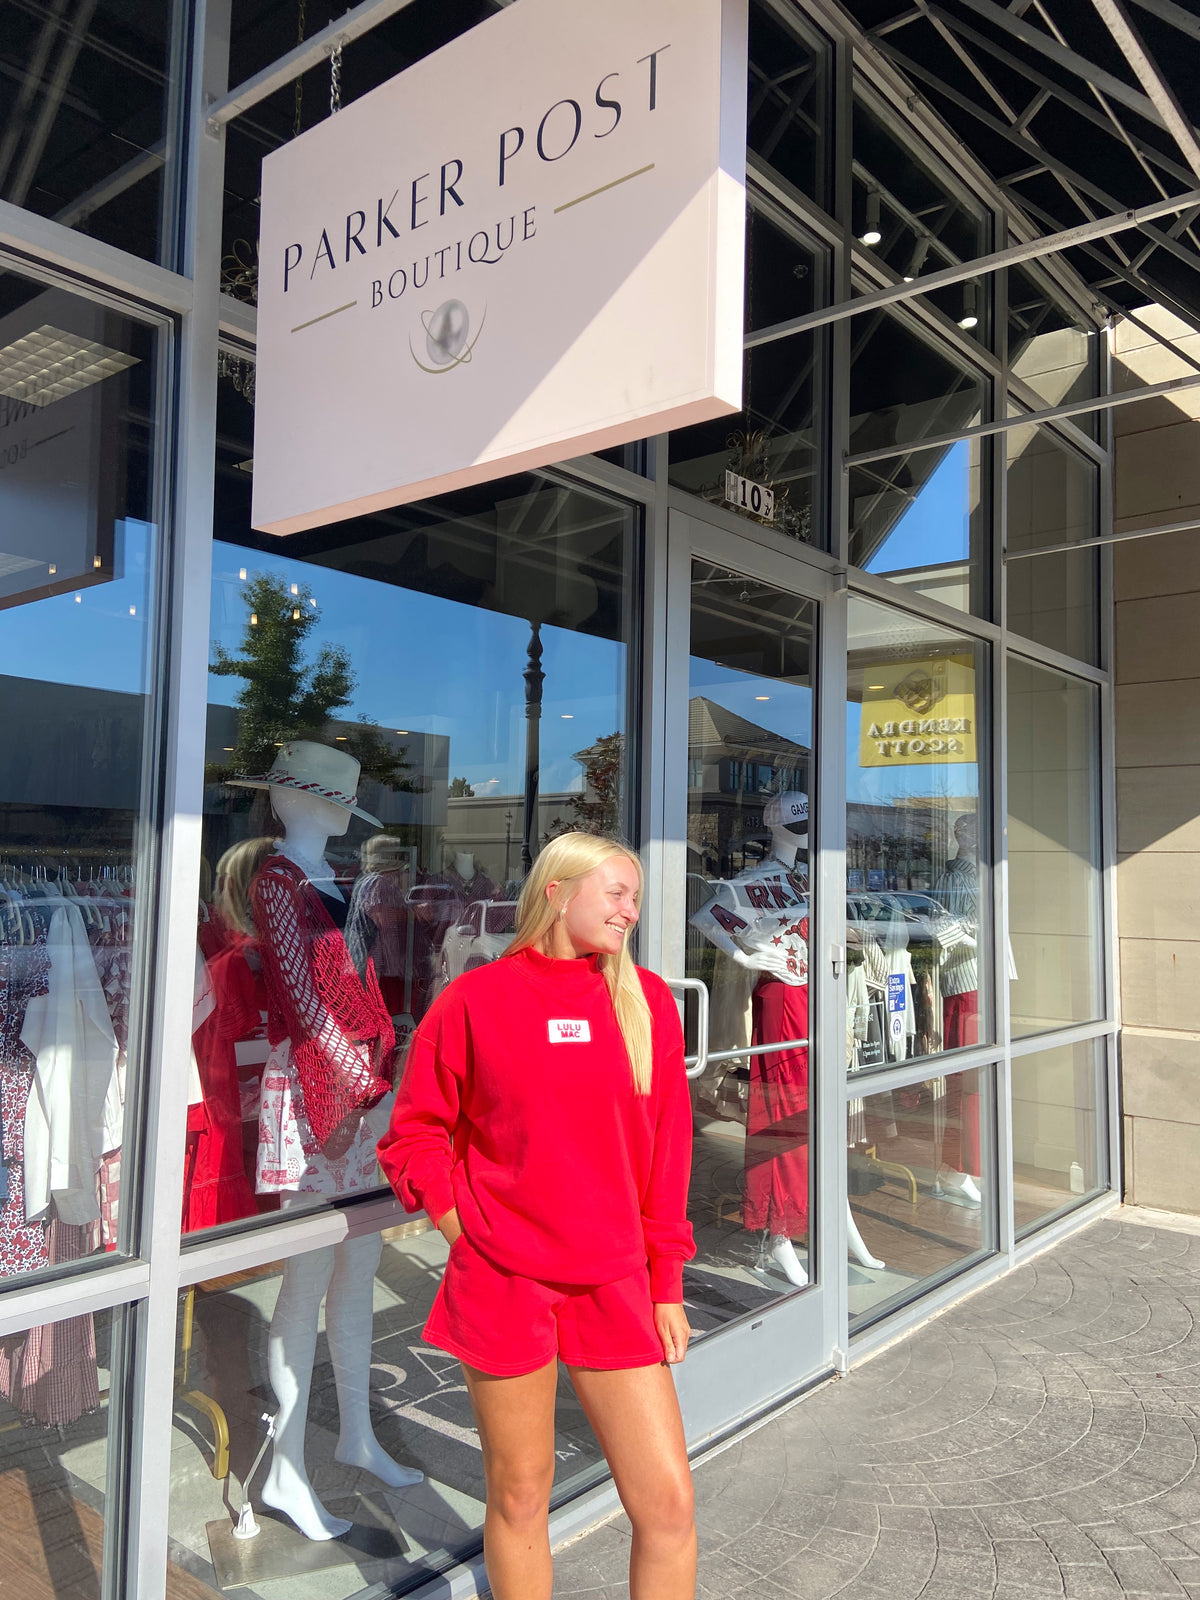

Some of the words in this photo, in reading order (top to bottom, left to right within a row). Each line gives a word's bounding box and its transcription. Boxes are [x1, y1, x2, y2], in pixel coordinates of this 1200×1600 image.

[283, 158, 465, 293] PARKER
[497, 43, 671, 187] POST
[370, 205, 537, 309] BOUTIQUE
[557, 1023, 581, 1031] LULU
